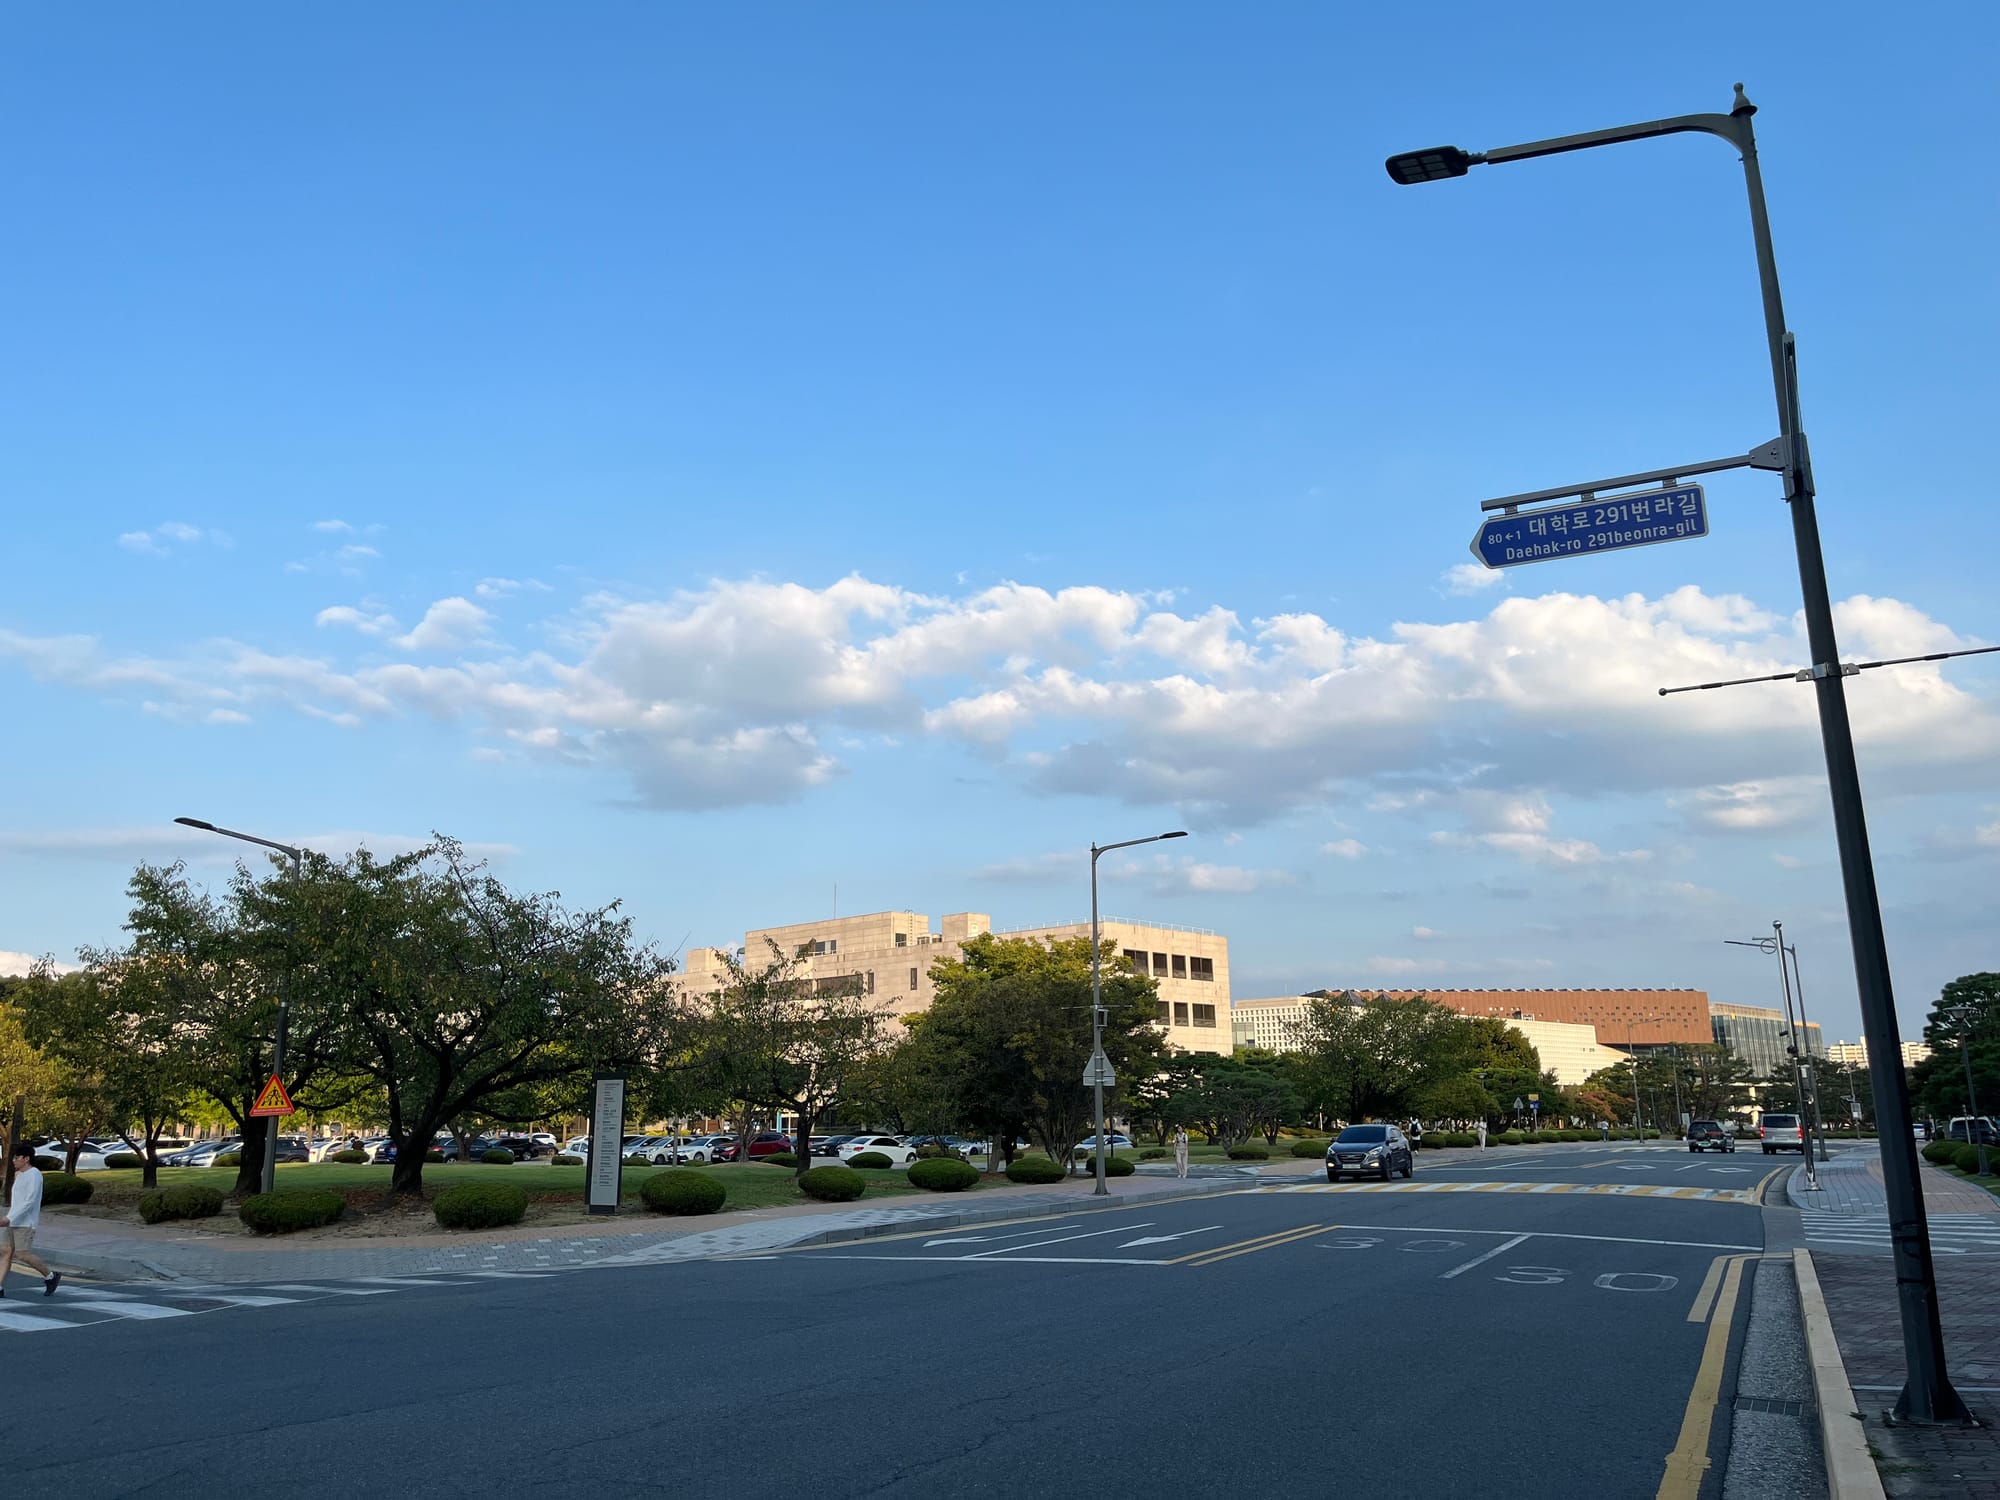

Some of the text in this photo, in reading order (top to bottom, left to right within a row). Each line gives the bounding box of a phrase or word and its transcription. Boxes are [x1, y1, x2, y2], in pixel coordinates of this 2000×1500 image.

[1488, 530, 1521, 545] 80 1
[1506, 518, 1697, 560] Daehak-ro 291beonra-gil
[1313, 1236, 1467, 1253] 30
[1493, 1266, 1679, 1292] 30
